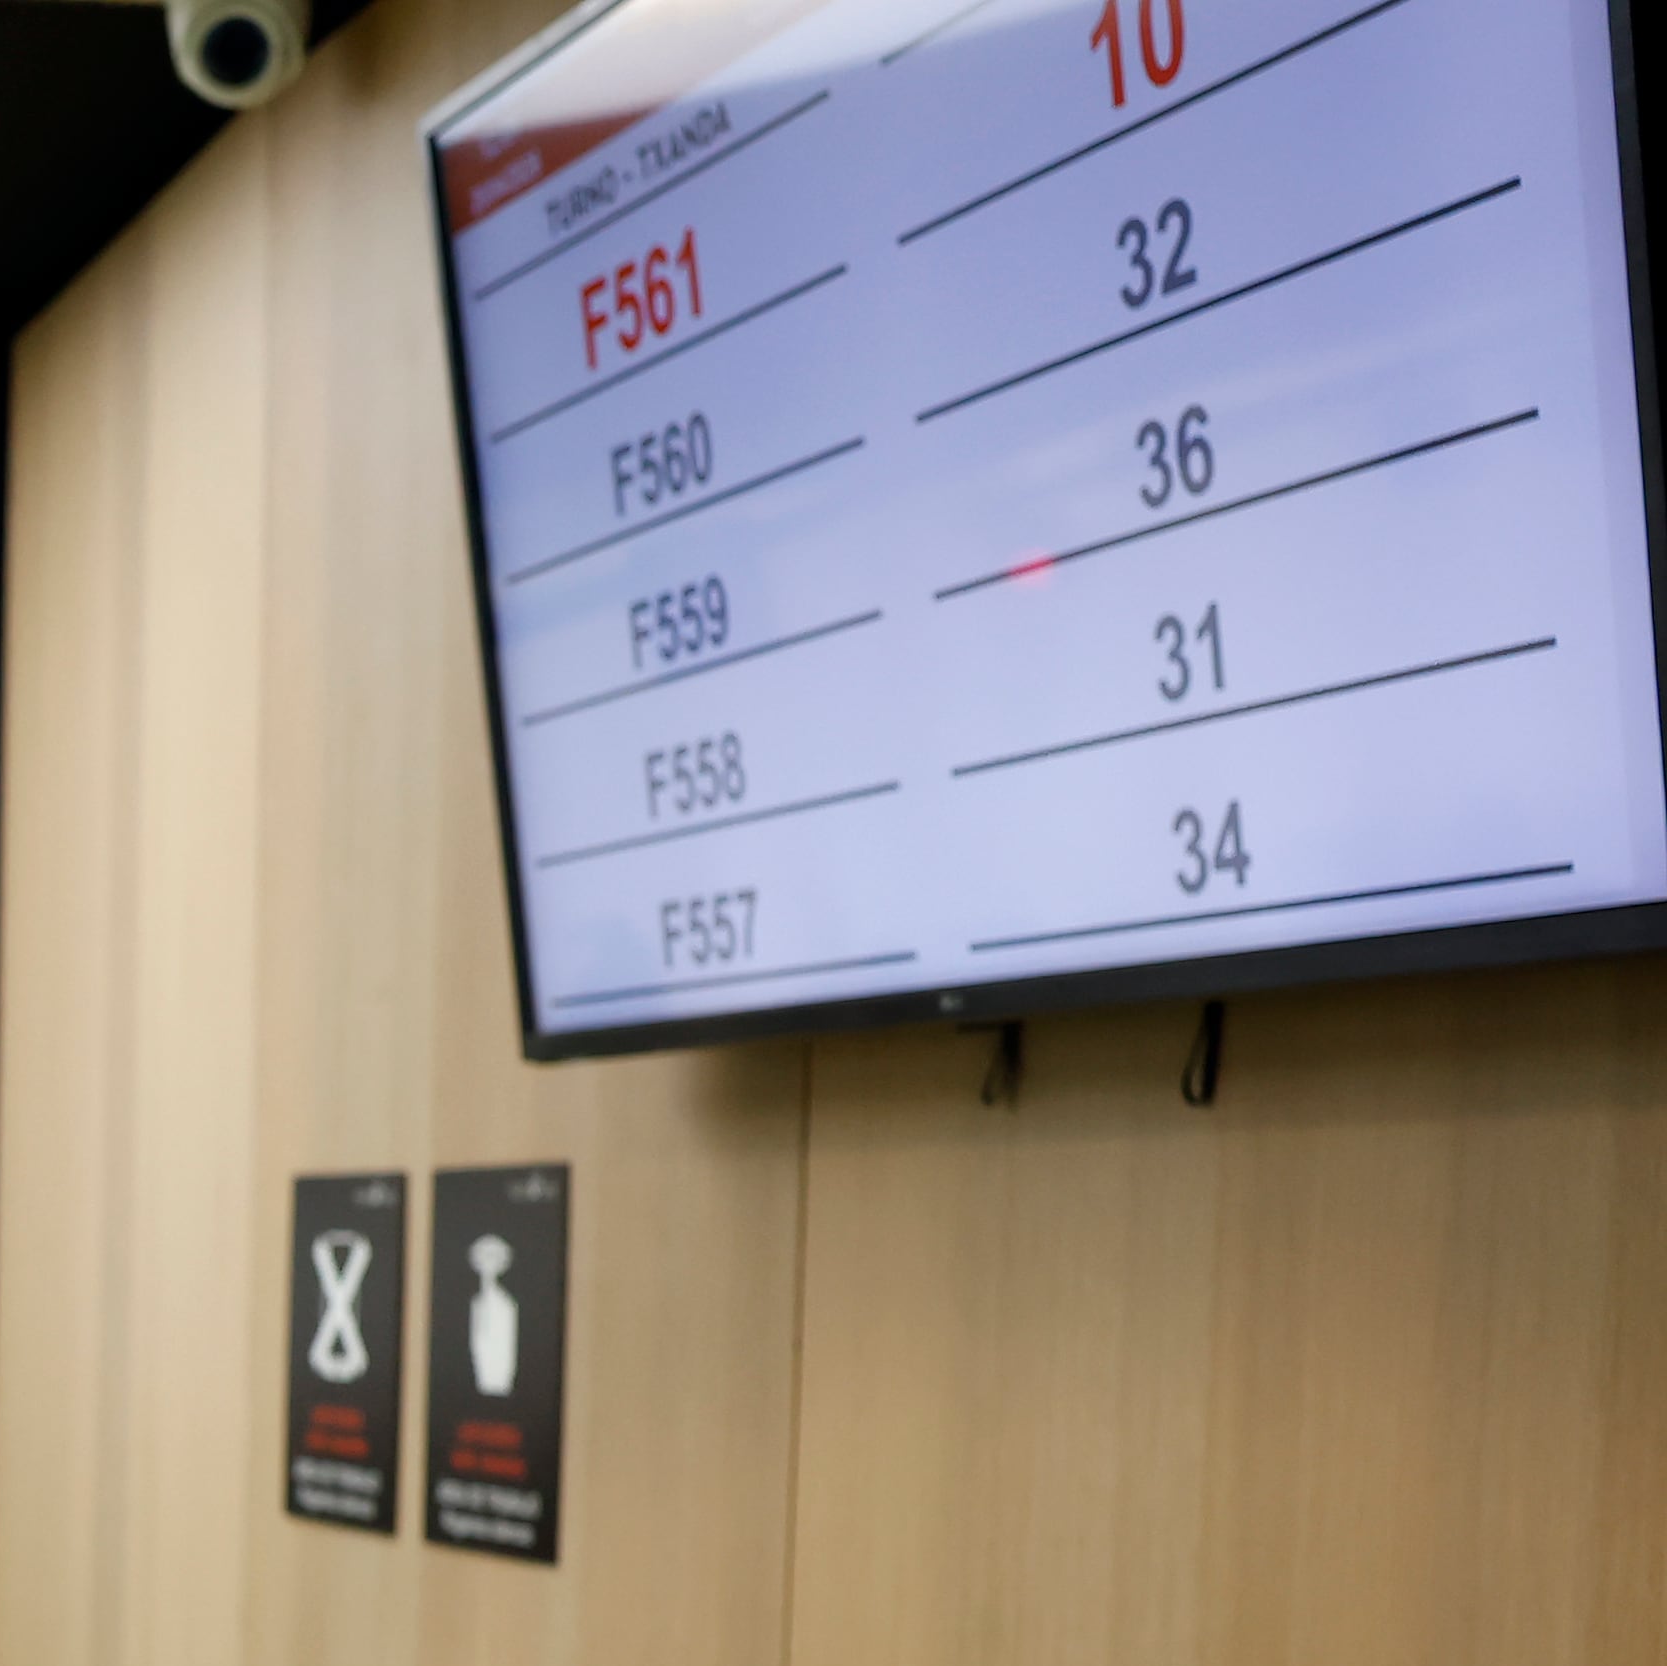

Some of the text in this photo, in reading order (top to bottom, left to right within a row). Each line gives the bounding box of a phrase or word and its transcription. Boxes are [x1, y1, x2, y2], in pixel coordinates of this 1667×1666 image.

[578, 0, 1184, 369] F561 10
[611, 199, 1198, 516] F560 32
[629, 405, 1215, 669] F559 36
[645, 602, 1228, 819] F558 31
[660, 800, 1251, 967] F557 34
